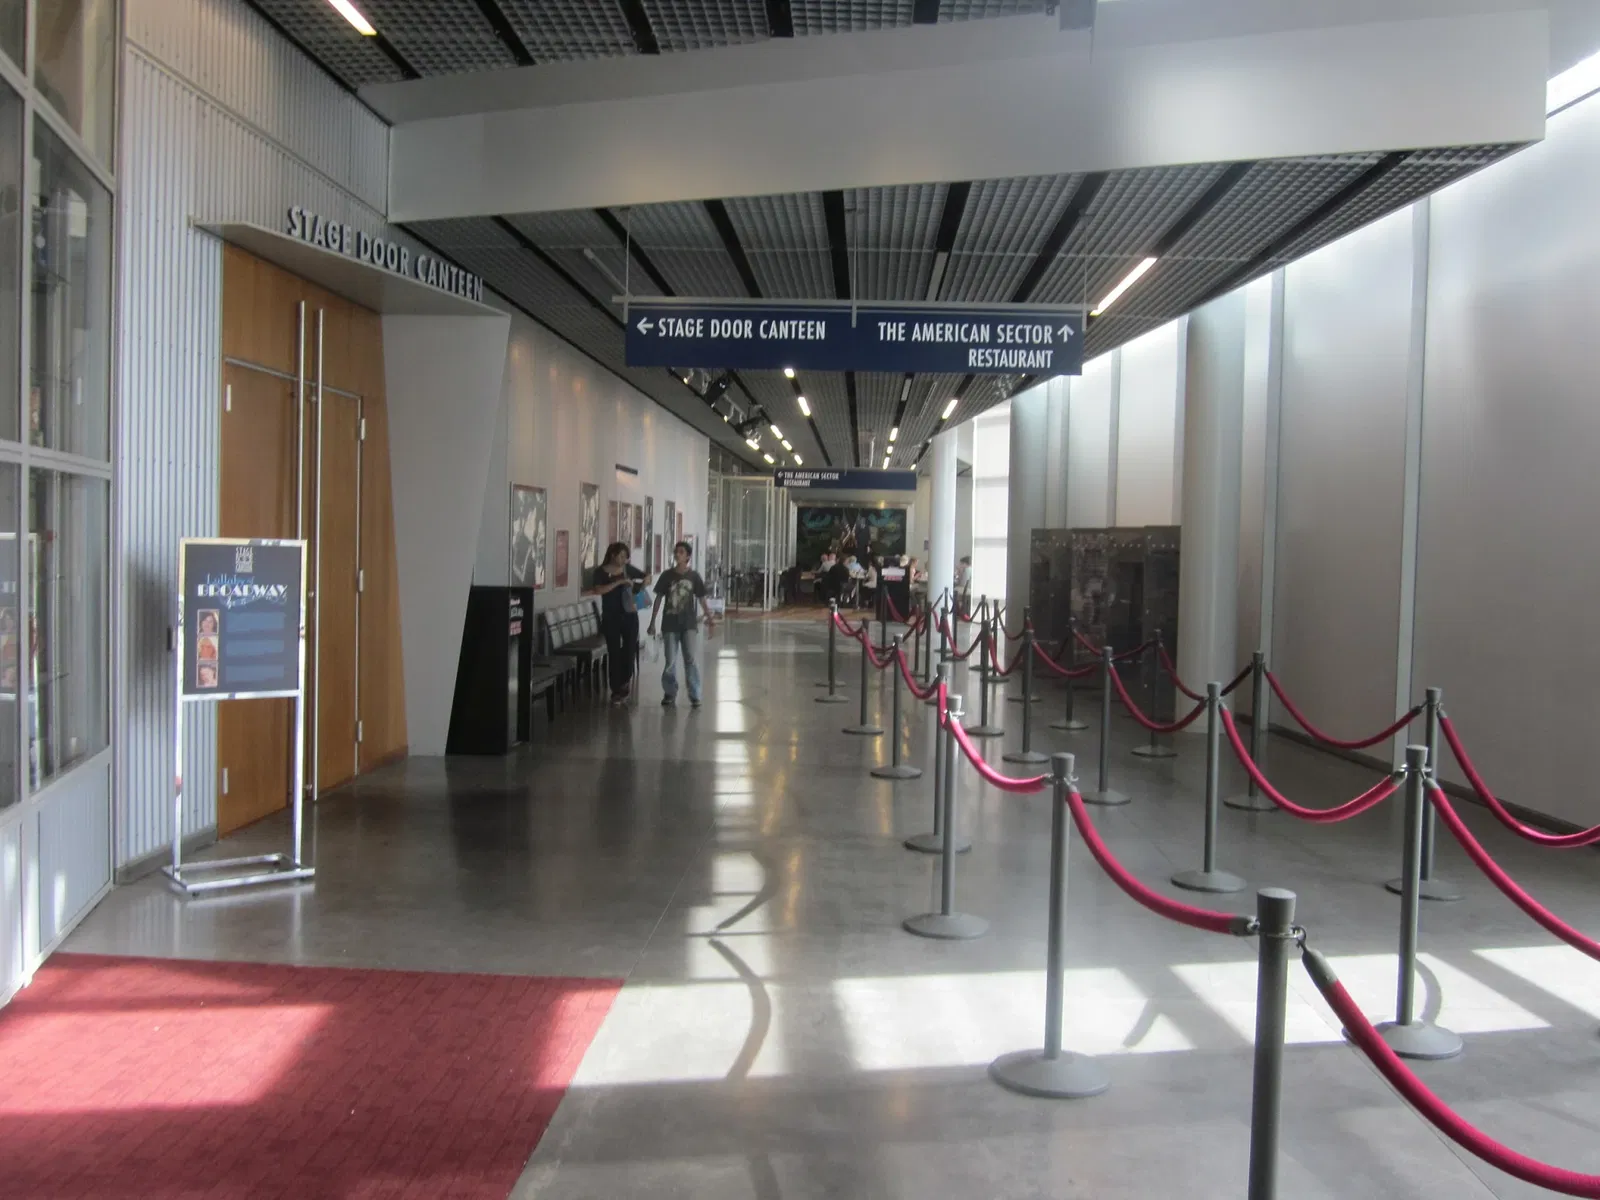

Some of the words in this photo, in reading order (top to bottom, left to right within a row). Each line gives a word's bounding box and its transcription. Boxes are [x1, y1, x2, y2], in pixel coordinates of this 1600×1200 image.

[288, 206, 351, 254] STAGE
[357, 231, 409, 275] DOOR
[415, 254, 483, 301] CANTEEN
[658, 318, 704, 337] STAGE
[710, 319, 753, 338] DOOR
[759, 320, 826, 340] CANTEEN
[878, 322, 906, 341] THE
[911, 322, 990, 343] AMERICAN
[997, 324, 1053, 344] SECTOR
[968, 348, 1053, 368] RESTAURANT
[784, 471, 794, 479] THE
[795, 471, 820, 479] AMERICAN
[820, 472, 840, 480] SECTOR
[197, 584, 288, 597] BROADWAY
